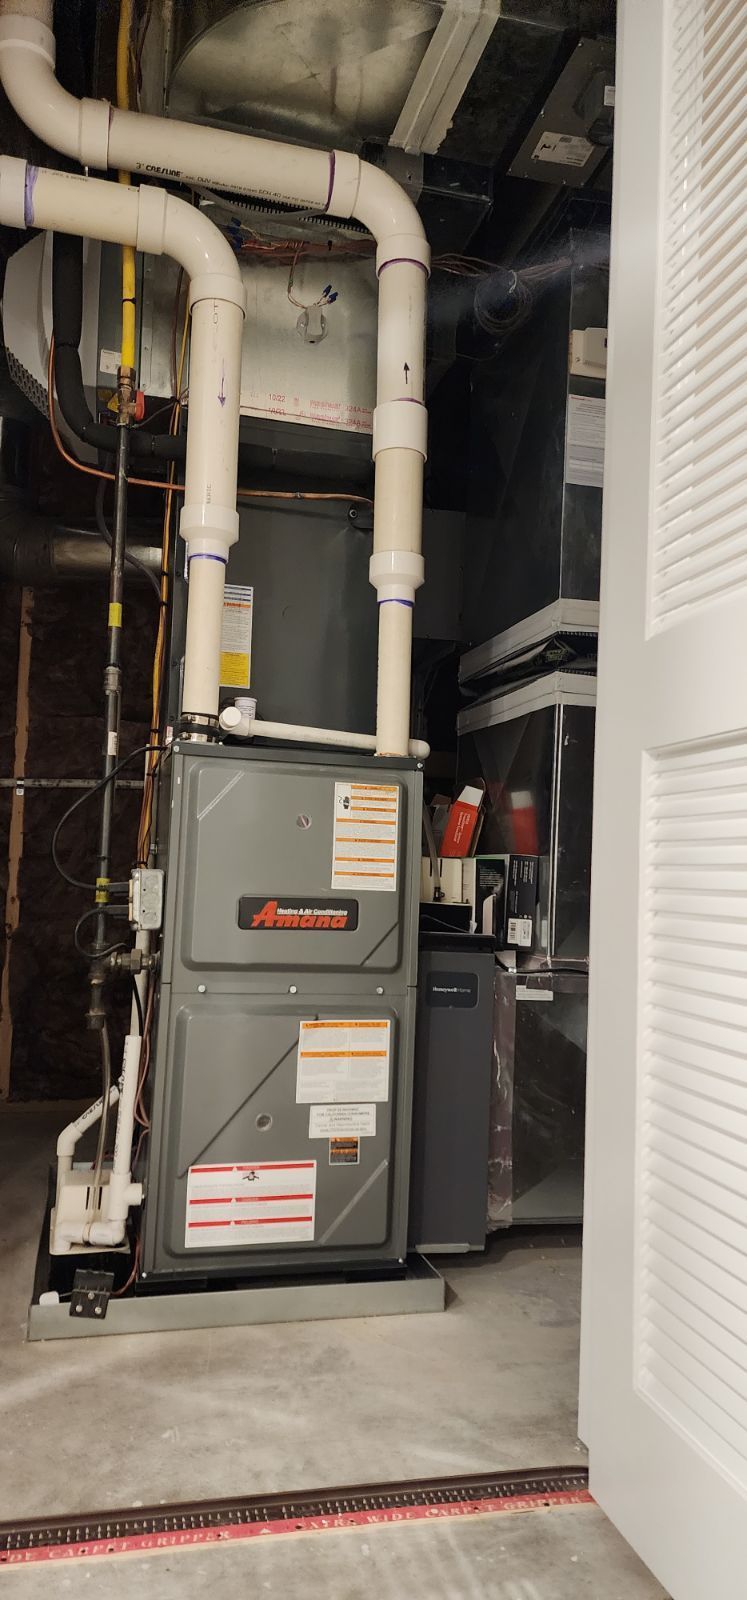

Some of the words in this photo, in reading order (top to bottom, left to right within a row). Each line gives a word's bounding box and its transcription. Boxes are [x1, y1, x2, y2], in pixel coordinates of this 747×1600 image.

[251, 901, 347, 928] Amana
[276, 908, 298, 916] Heating
[304, 908, 312, 916] Air
[313, 908, 348, 916] Conditioning
[432, 985, 457, 994] Honeywell
[367, 1511, 416, 1523] WIDE
